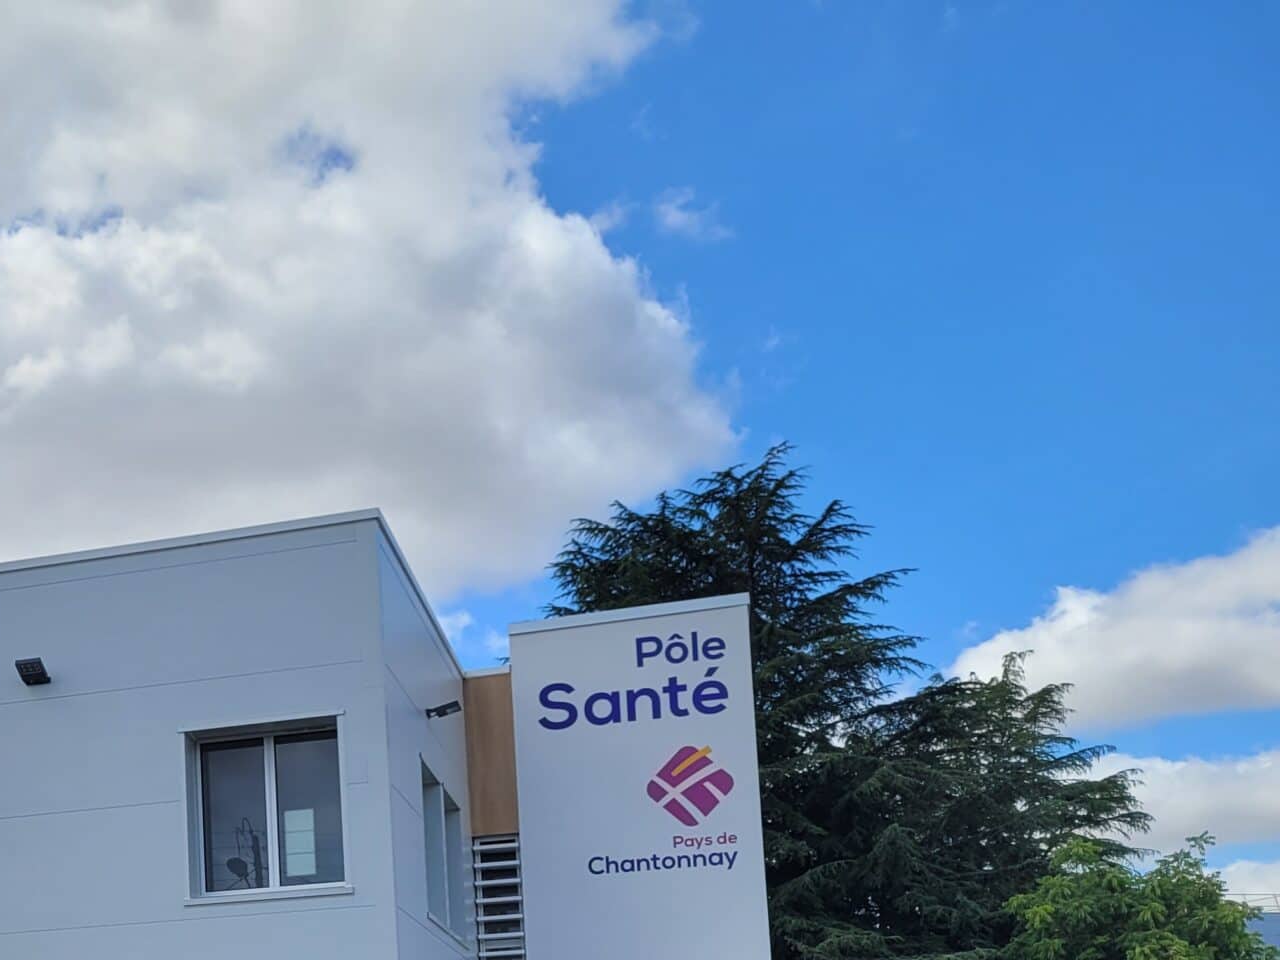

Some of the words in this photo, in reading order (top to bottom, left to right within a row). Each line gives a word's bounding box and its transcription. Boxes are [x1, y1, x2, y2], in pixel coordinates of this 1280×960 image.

[635, 631, 727, 668] Pôle
[538, 666, 729, 730] Santé
[672, 835, 713, 850] Pays
[716, 832, 738, 845] de
[588, 850, 738, 875] Chantonnay
